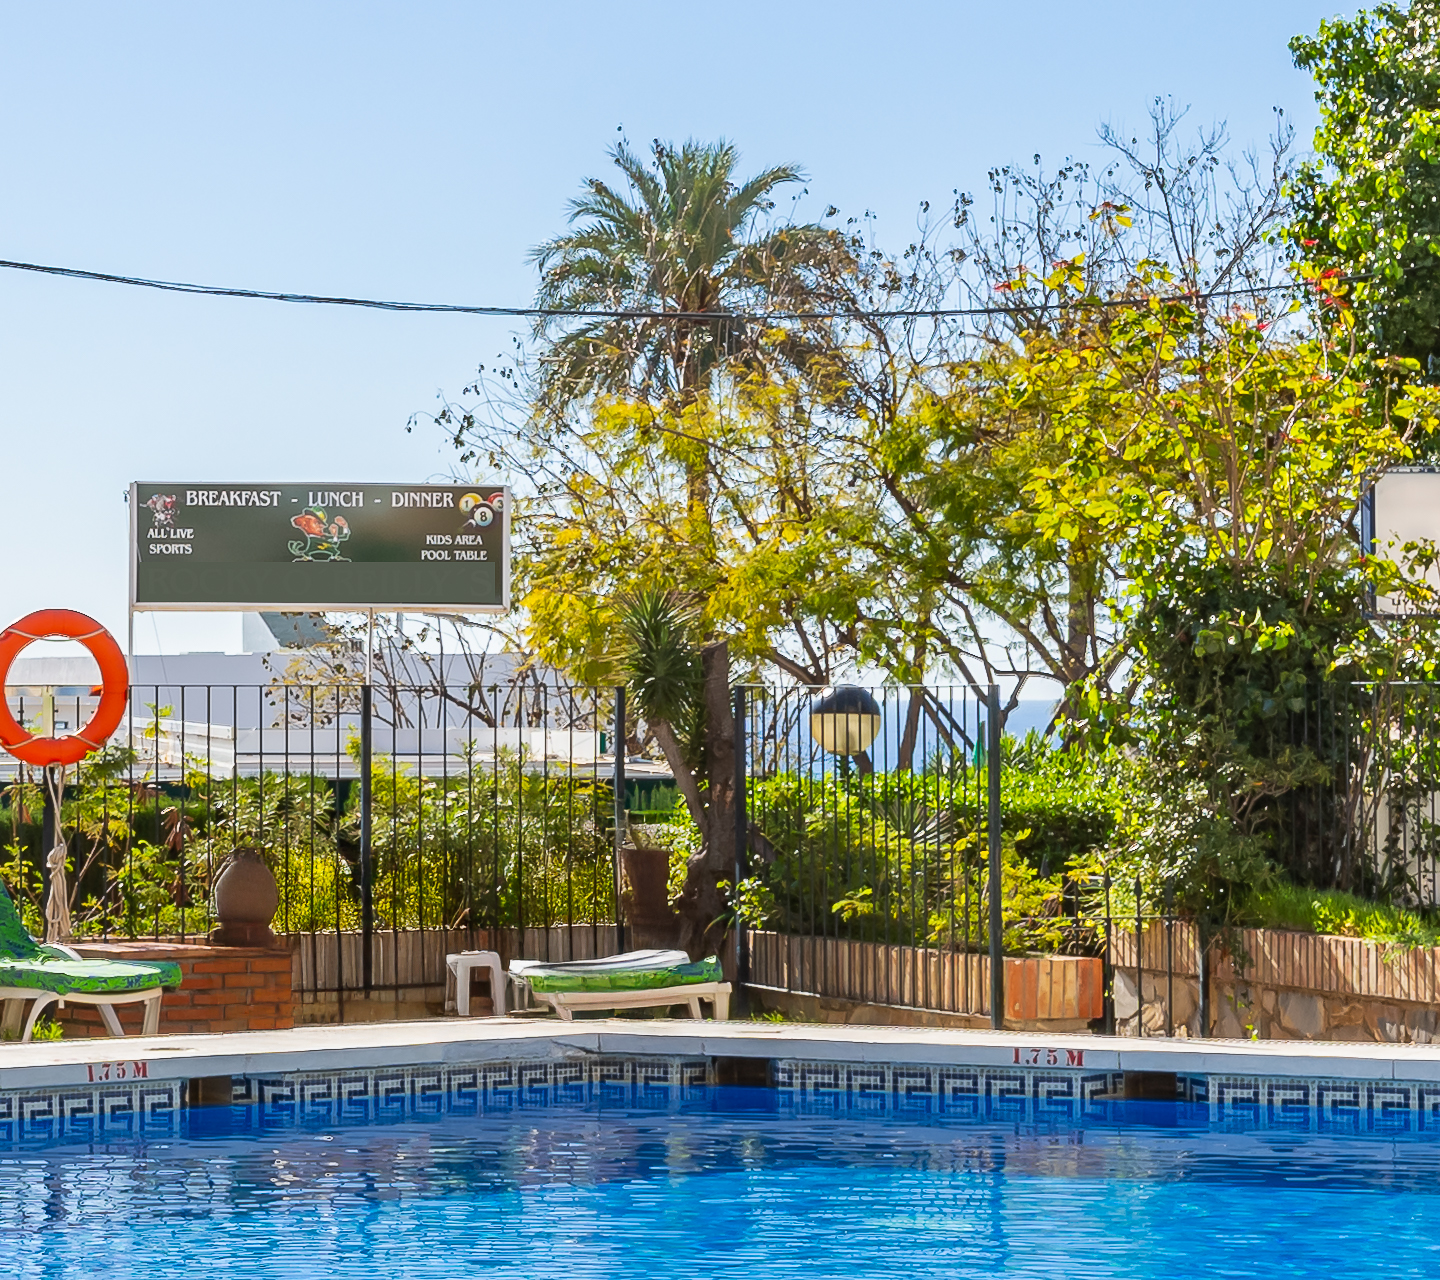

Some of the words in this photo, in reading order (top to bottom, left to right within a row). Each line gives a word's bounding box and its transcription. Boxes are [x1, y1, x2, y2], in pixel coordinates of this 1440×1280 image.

[186, 490, 281, 506] BREAKFAST
[308, 491, 364, 507] LUNCH
[391, 492, 454, 508] DINNER
[480, 511, 487, 521] 8
[147, 528, 167, 539] ALL
[170, 528, 194, 539] LIVE
[426, 534, 452, 545] KIDS
[454, 535, 483, 545] AREA
[149, 543, 193, 554] SPORTS
[421, 550, 451, 561] POOL
[454, 550, 487, 561] TABLE
